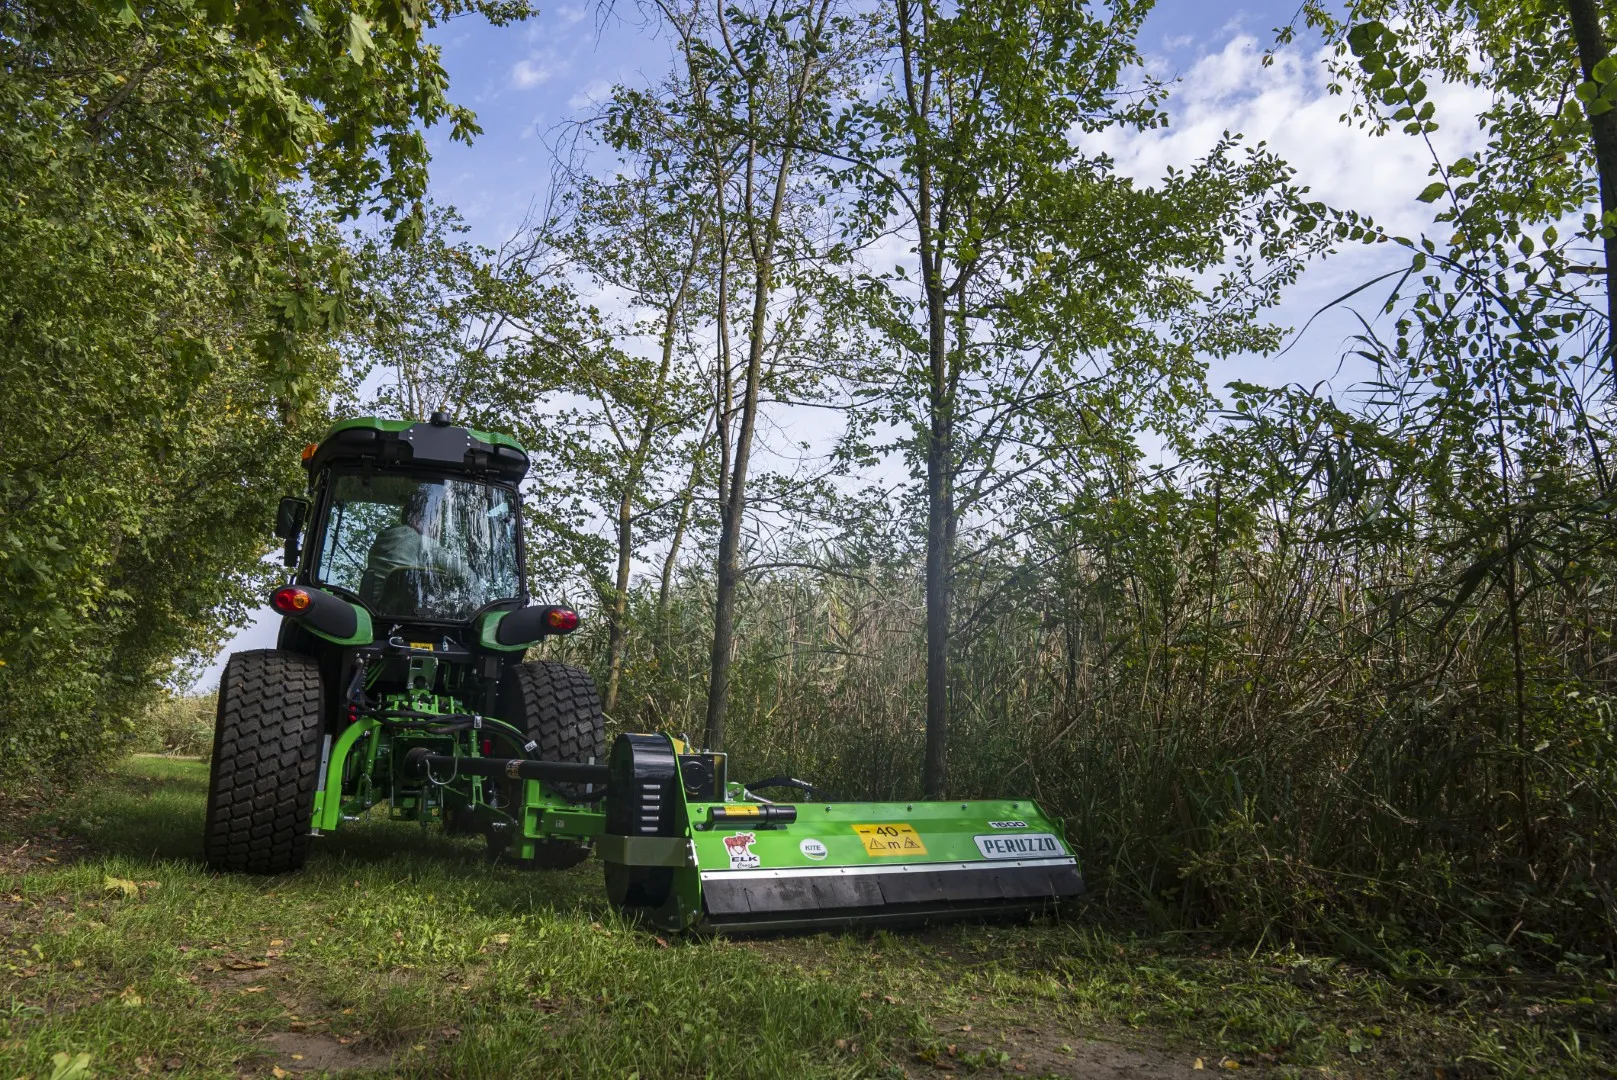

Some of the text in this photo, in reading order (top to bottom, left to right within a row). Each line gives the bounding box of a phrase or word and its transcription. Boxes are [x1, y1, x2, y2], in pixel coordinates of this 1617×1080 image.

[876, 826, 899, 837] 40
[887, 841, 901, 849] m
[983, 837, 1057, 854] PERUZZO
